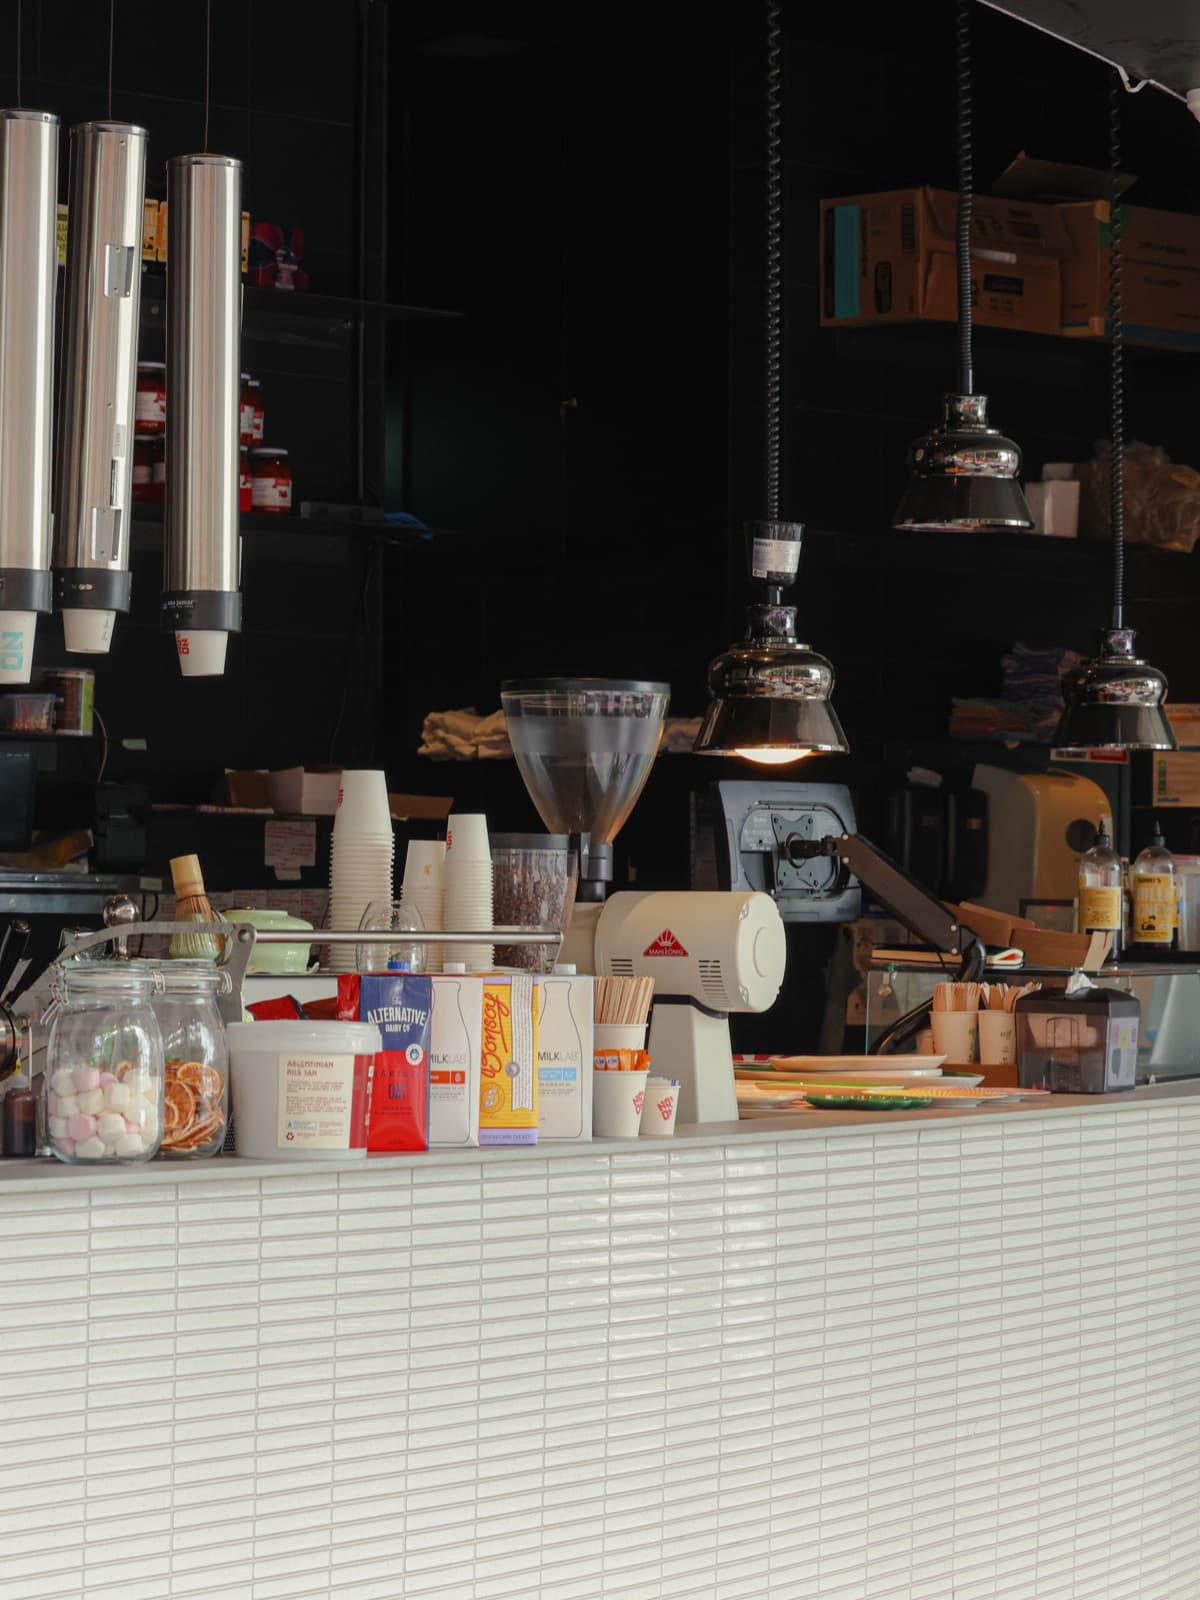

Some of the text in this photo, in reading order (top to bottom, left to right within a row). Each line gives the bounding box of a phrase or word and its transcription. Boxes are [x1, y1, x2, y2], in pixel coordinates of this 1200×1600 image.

[367, 1006, 427, 1027] ALTERNATIVE
[385, 1024, 402, 1033] DAIRY
[430, 1054, 467, 1064] ILKLAB
[388, 1083, 406, 1099] OAT
